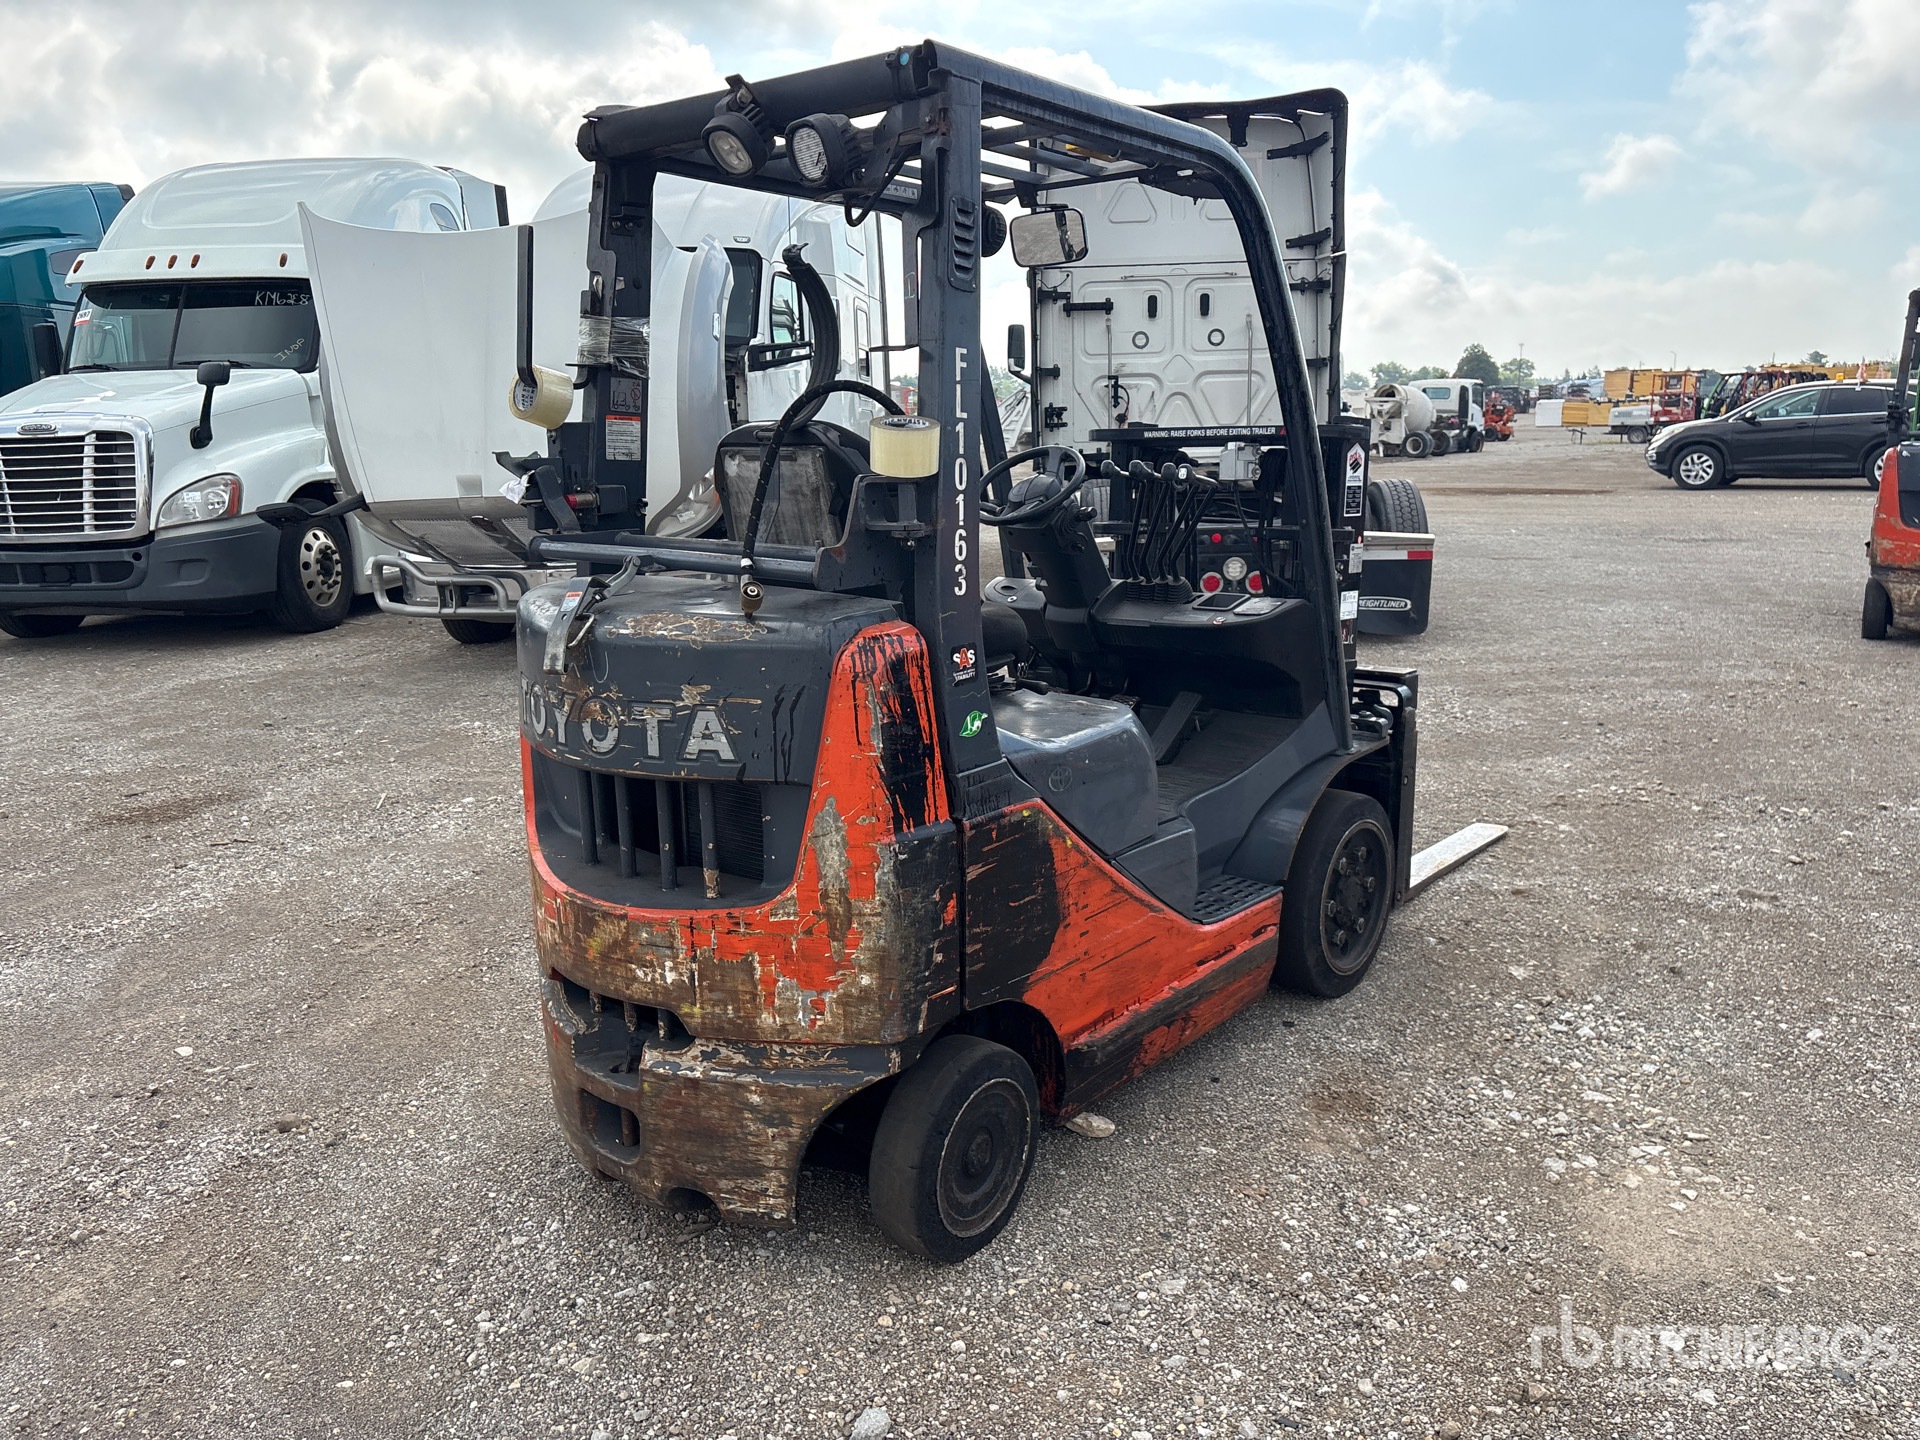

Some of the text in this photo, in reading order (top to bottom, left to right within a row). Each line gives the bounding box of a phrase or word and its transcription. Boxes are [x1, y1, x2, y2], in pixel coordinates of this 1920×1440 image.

[1144, 430, 1169, 438] WARNING:
[1187, 429, 1206, 437] FORKS
[1206, 428, 1229, 436] BEFORE
[1229, 428, 1251, 436] EXITING
[1251, 427, 1275, 435] TRAILER
[954, 346, 968, 596] FL10163
[1359, 597, 1406, 608] REIGHTLINER
[953, 648, 975, 669] SAS
[521, 674, 735, 760] TOYOTA
